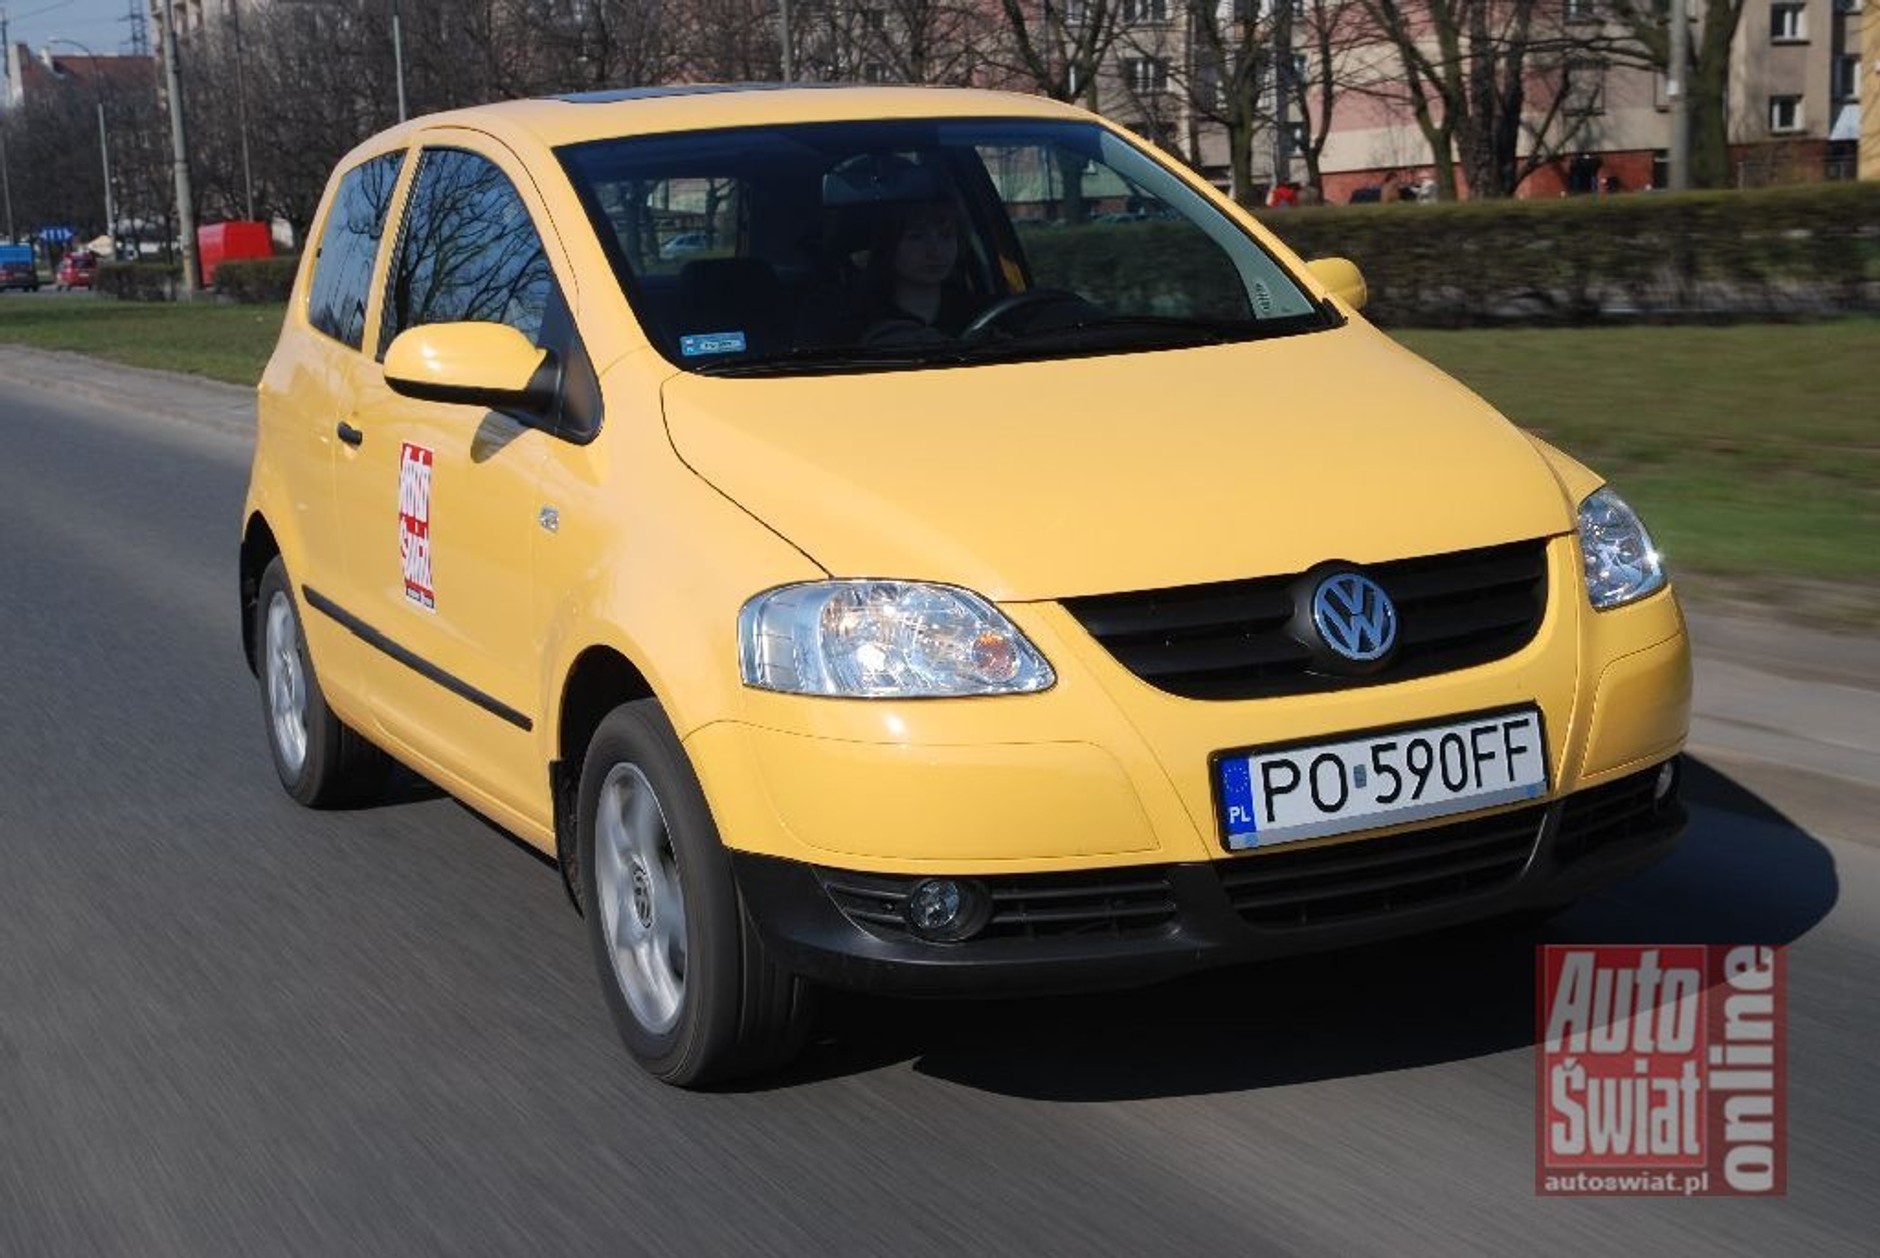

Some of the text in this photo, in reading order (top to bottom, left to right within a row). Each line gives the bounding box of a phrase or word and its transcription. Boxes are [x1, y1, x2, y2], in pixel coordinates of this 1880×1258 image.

[1260, 718, 1530, 823] PO 590FF
[1229, 805, 1251, 824] PL
